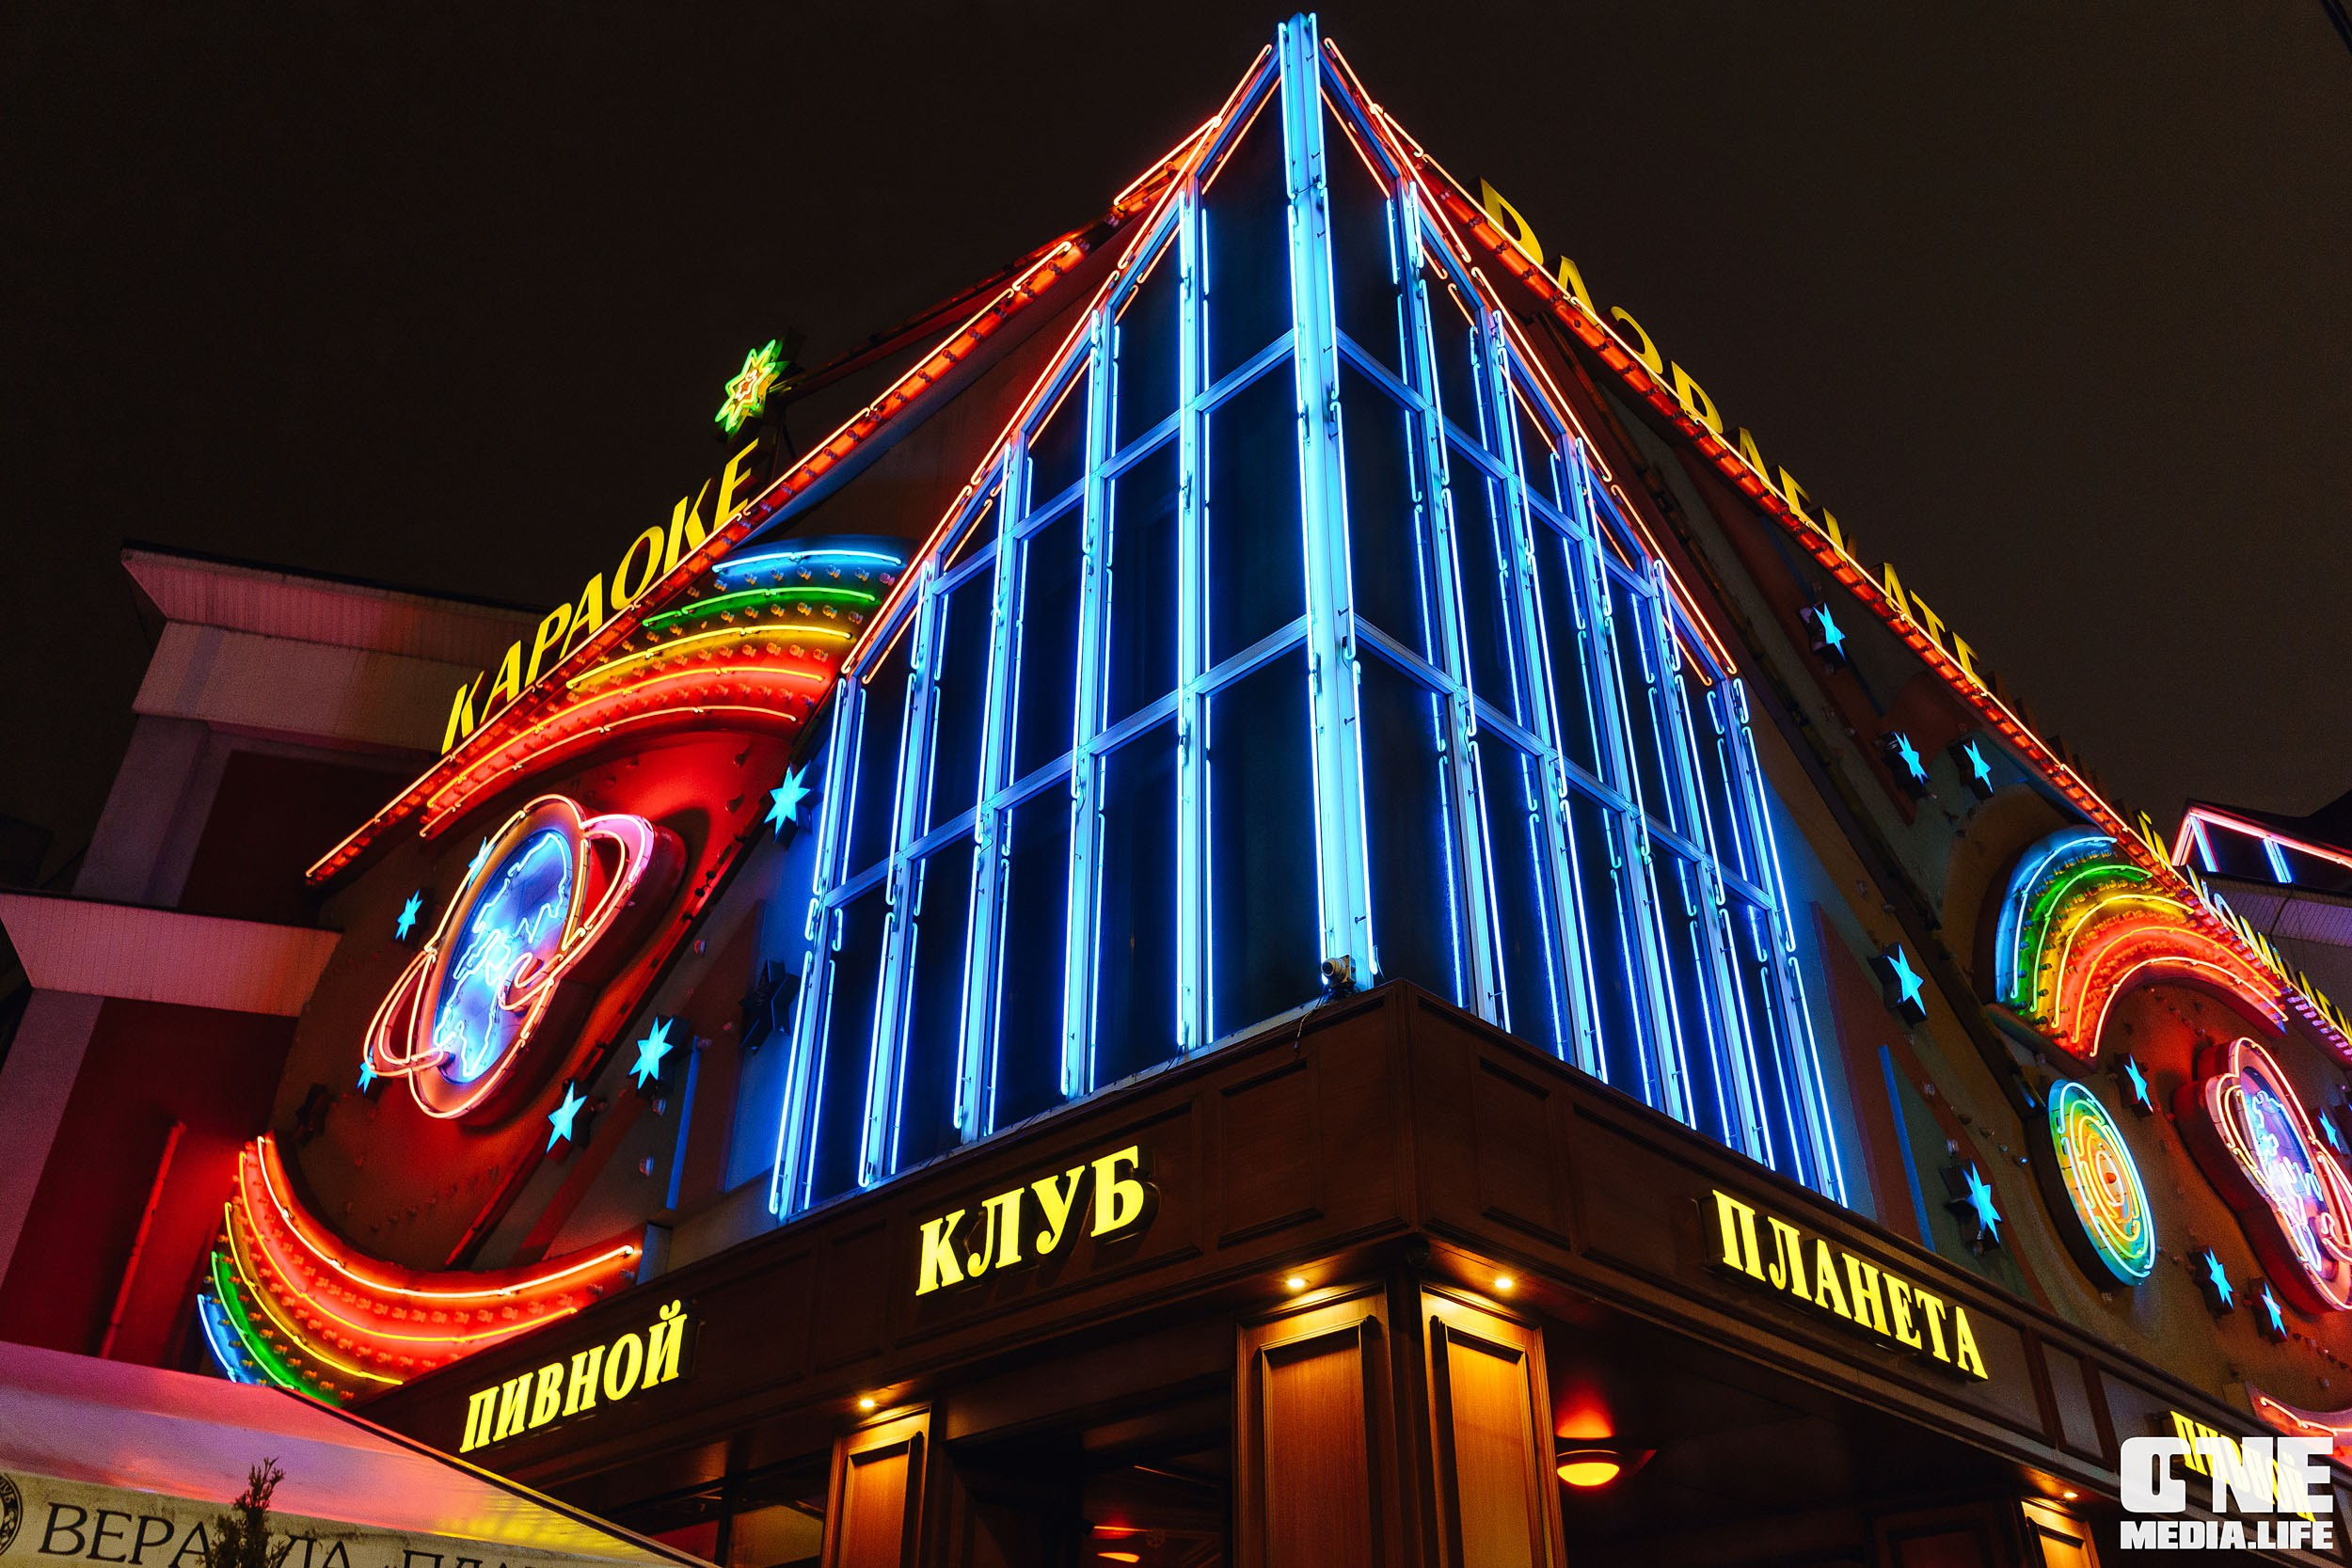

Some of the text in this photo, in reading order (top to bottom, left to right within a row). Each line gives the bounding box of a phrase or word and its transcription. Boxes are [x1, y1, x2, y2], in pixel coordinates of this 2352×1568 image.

[441, 437, 759, 755] КАРАОКЕ
[459, 1145, 1146, 1453] ПИВНОЙ КЛУБ
[1712, 1189, 1989, 1380] ПЛАНЕТА
